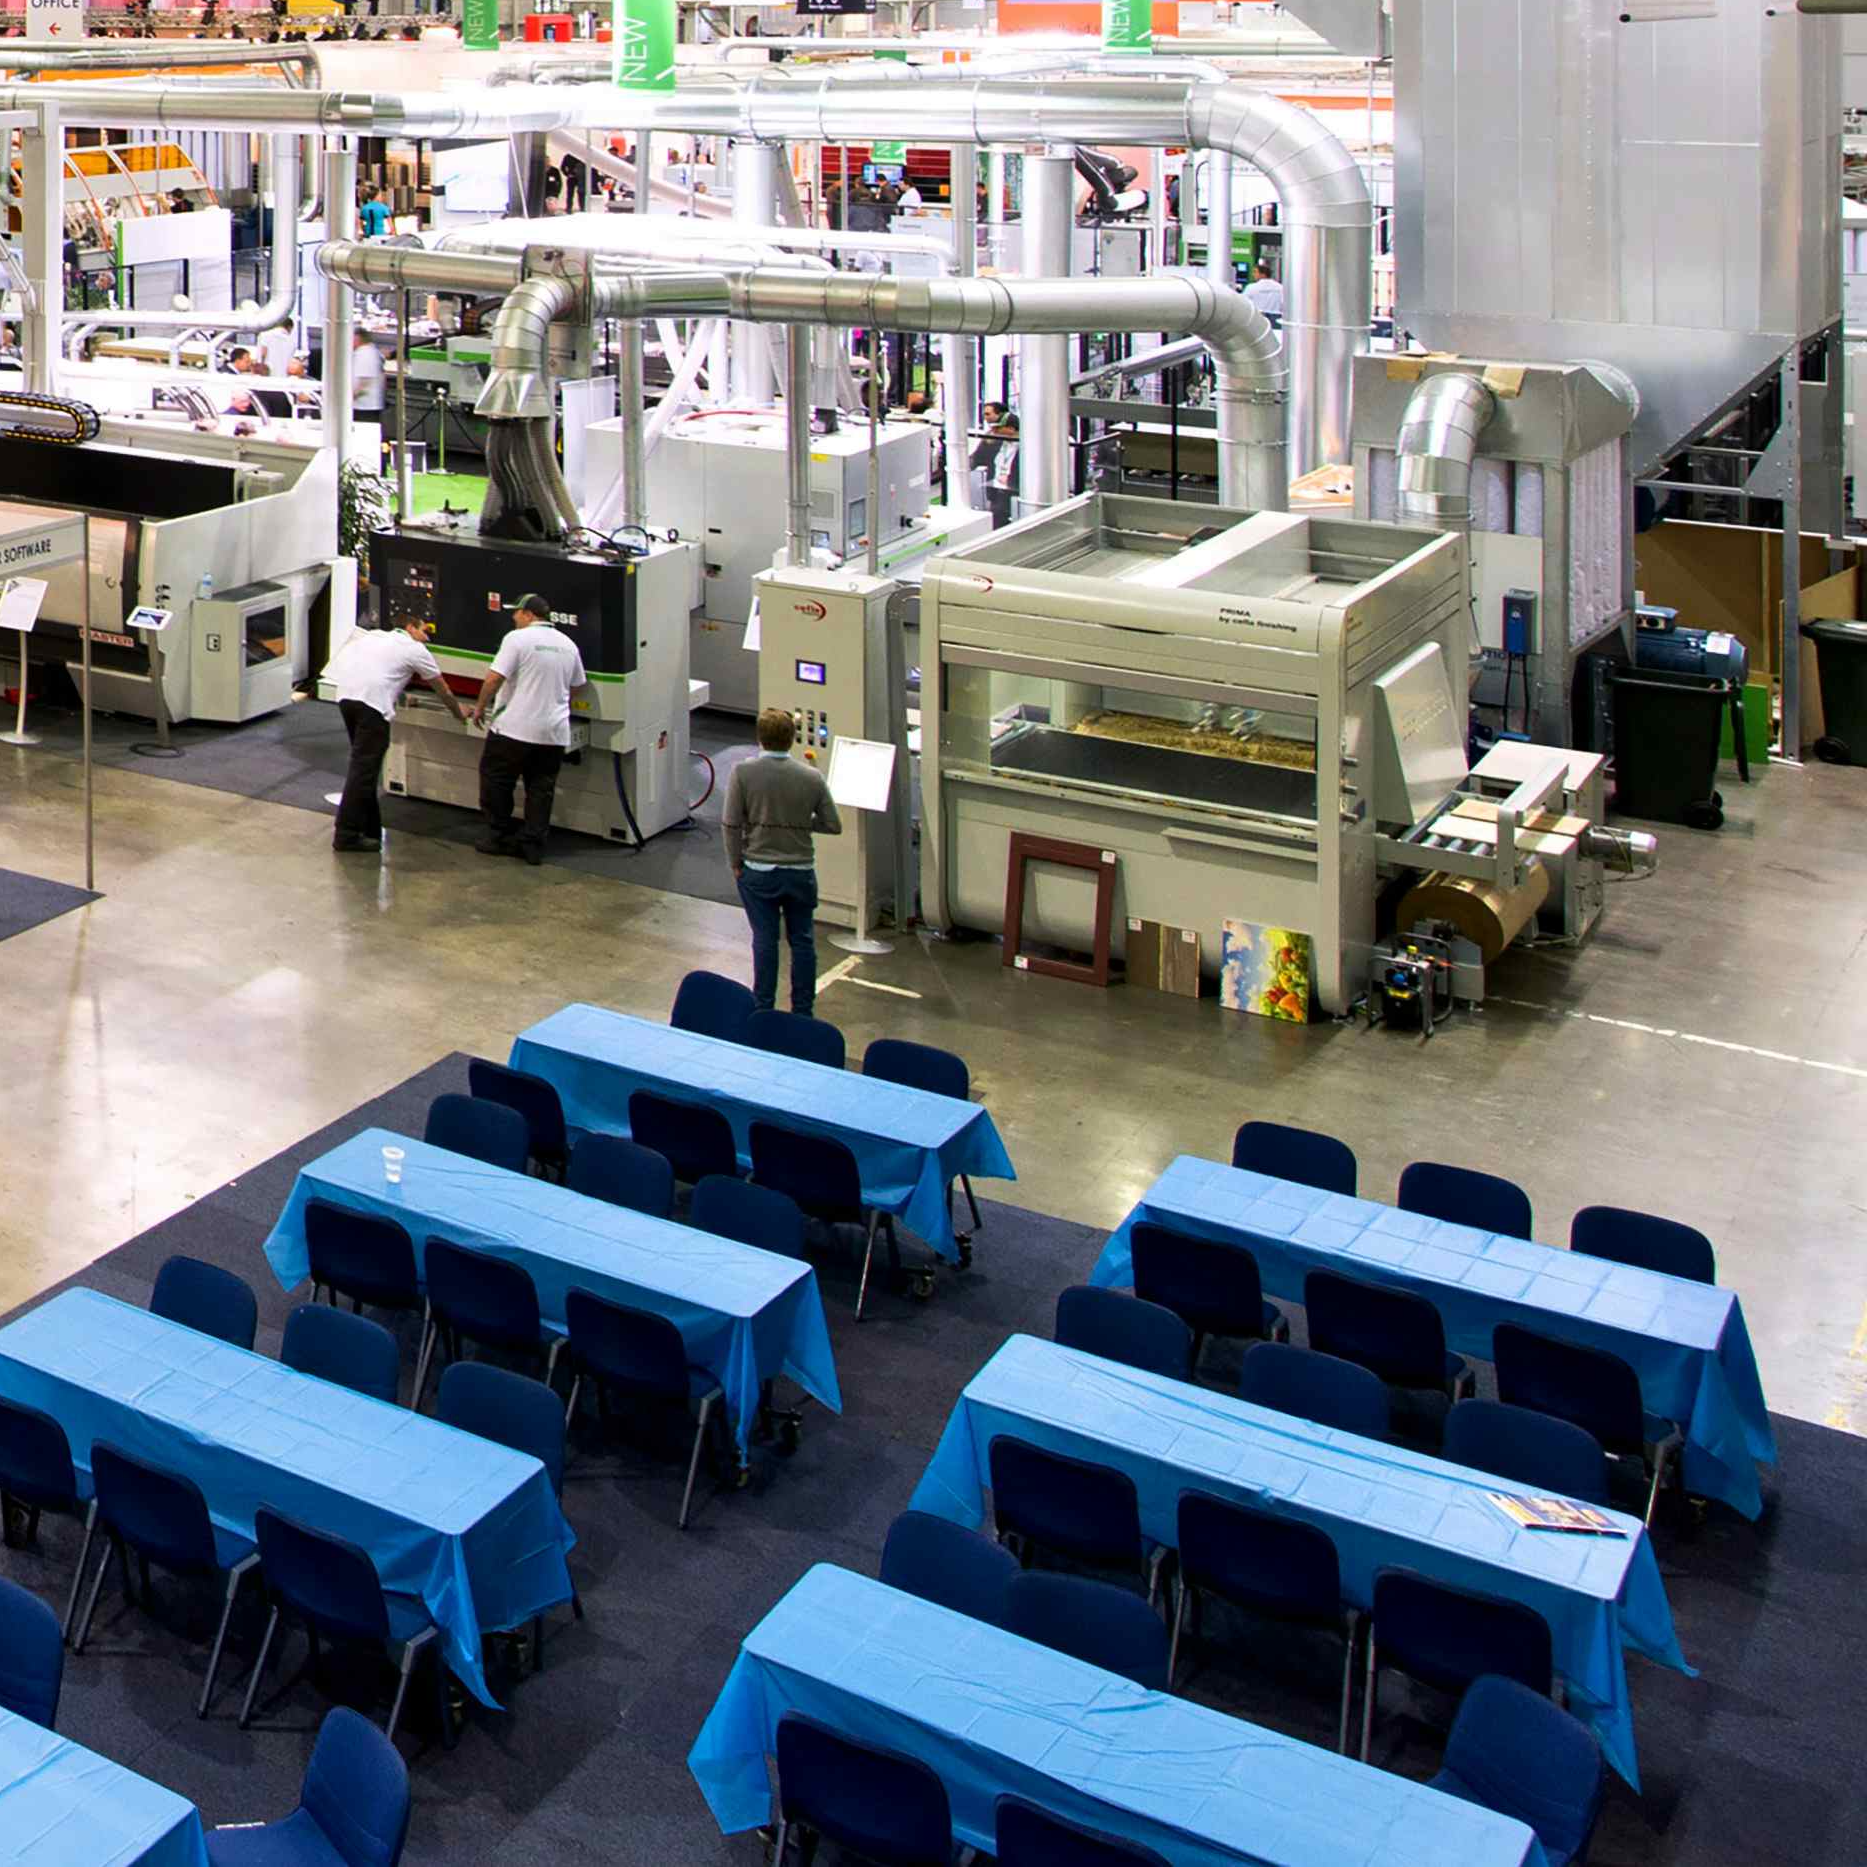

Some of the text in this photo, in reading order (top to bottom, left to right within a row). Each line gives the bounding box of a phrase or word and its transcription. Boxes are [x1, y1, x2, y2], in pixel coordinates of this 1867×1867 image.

[622, 16, 648, 82] NEW
[3, 538, 52, 566] SOFTWARE
[549, 611, 579, 627] SSE
[1220, 607, 1252, 617] PRIMA
[1218, 615, 1230, 624] by
[1257, 620, 1298, 633] finishing
